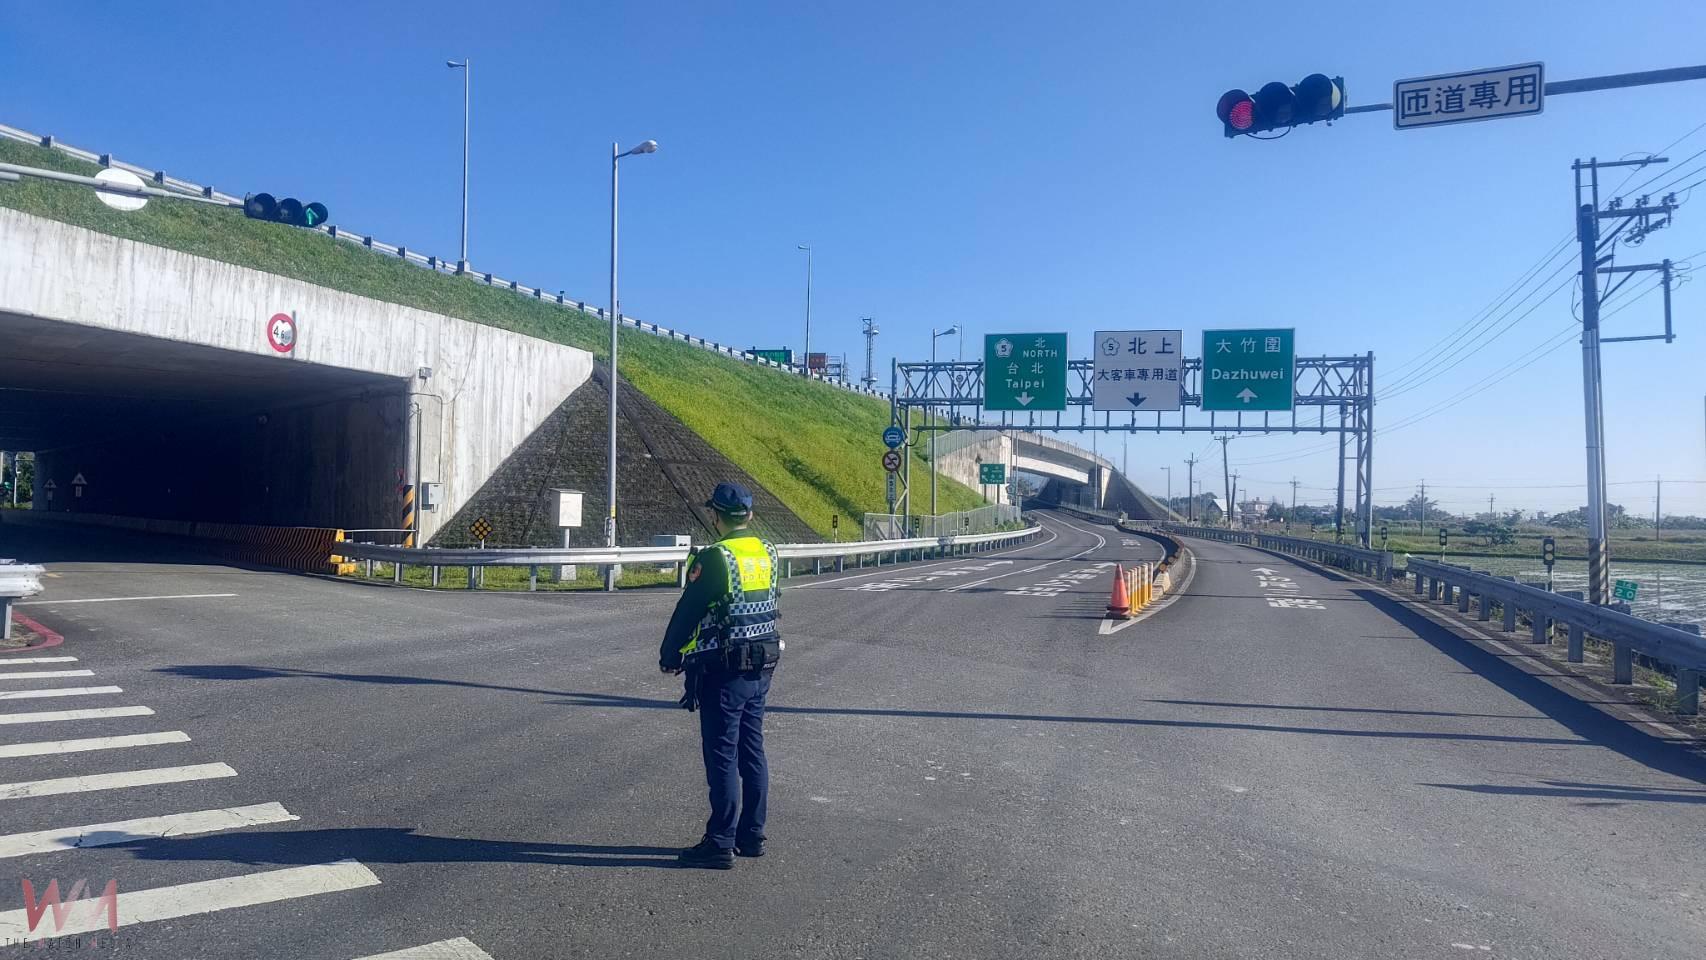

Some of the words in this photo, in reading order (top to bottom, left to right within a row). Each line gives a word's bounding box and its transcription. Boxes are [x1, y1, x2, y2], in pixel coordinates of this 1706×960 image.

[1400, 73, 1537, 120] 匝道專用
[1034, 336, 1046, 348] 北
[1128, 337, 1175, 355] 北上
[1215, 336, 1281, 353] 大竹圍
[1023, 349, 1058, 358] NORTH
[1006, 361, 1044, 375] 台北
[1097, 367, 1178, 382] 大客車專用道
[1211, 367, 1284, 380] Dazhuwei
[1005, 378, 1045, 390] Taipei
[1615, 588, 1634, 599] 20
